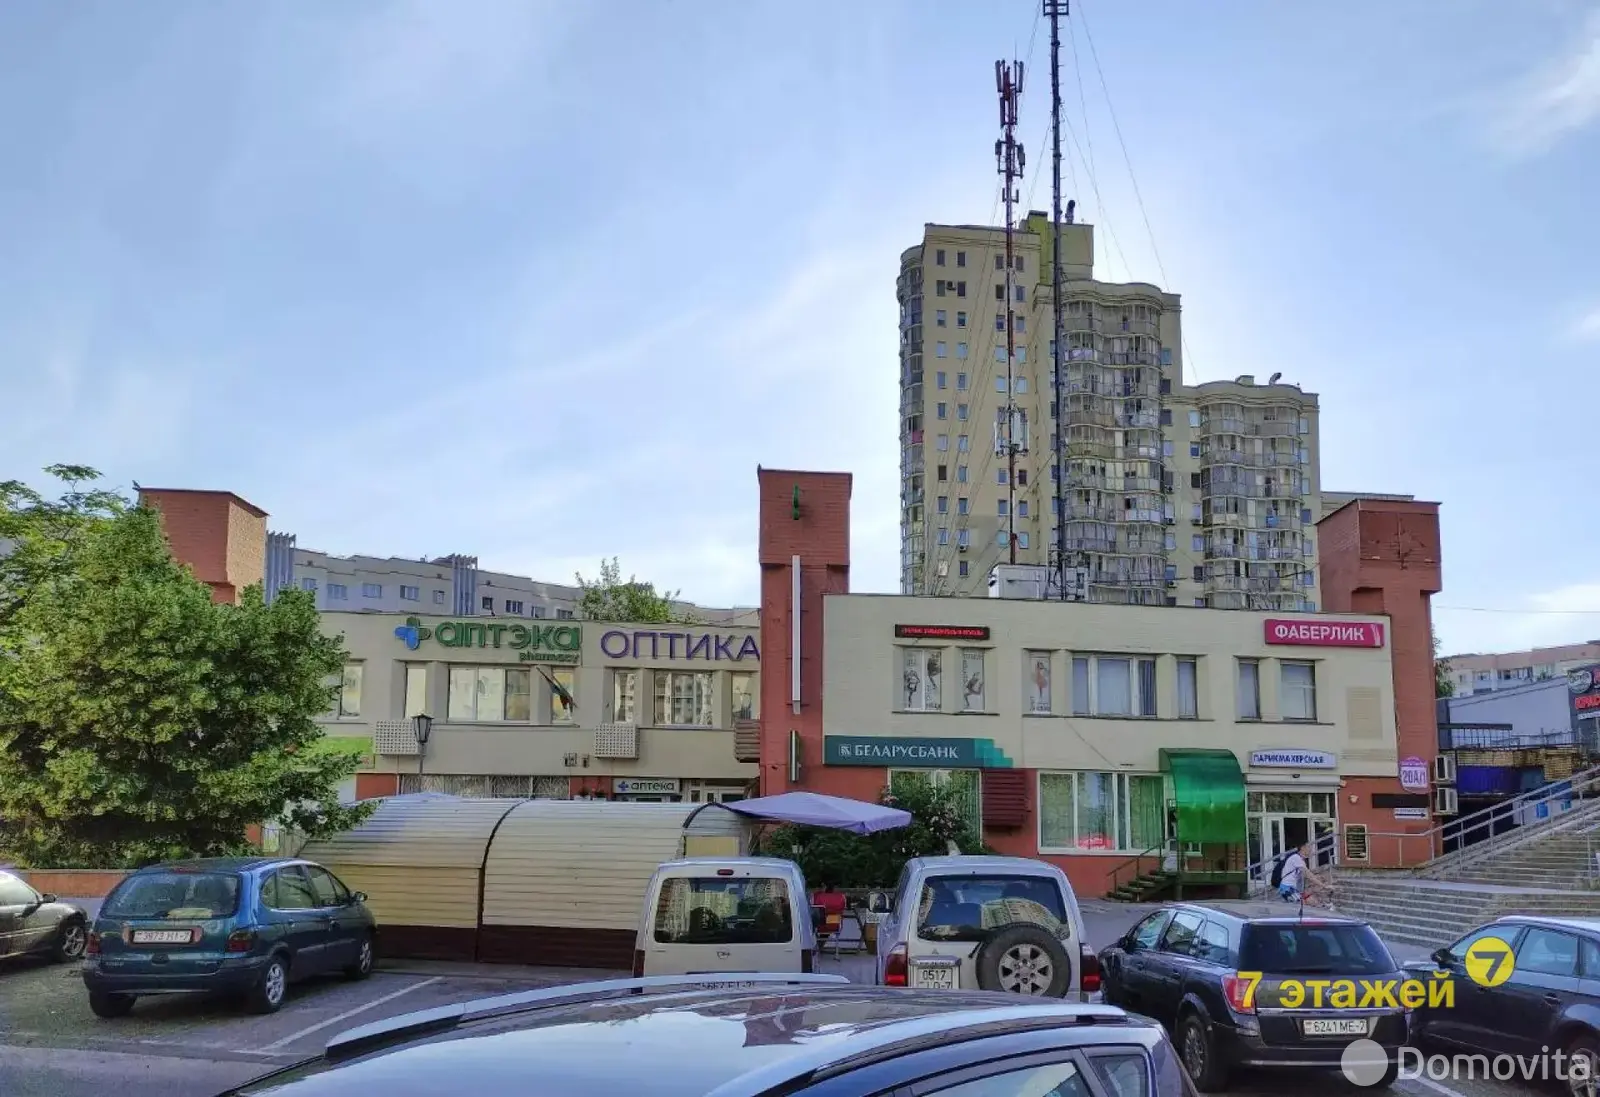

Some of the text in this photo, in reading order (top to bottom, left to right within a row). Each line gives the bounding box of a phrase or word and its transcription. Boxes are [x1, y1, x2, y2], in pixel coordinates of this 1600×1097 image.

[435, 621, 580, 650] аптэка
[1274, 624, 1365, 641] ФАБЕРЛИК
[600, 630, 761, 661] ОПТИКА
[854, 744, 959, 759] БЕЛАРУСБАНК
[1253, 753, 1324, 764] ПАРИКМАХЕРСКАЯ
[630, 780, 676, 791] аптека
[922, 969, 947, 981] 0517
[1314, 1021, 1337, 1033] 6241
